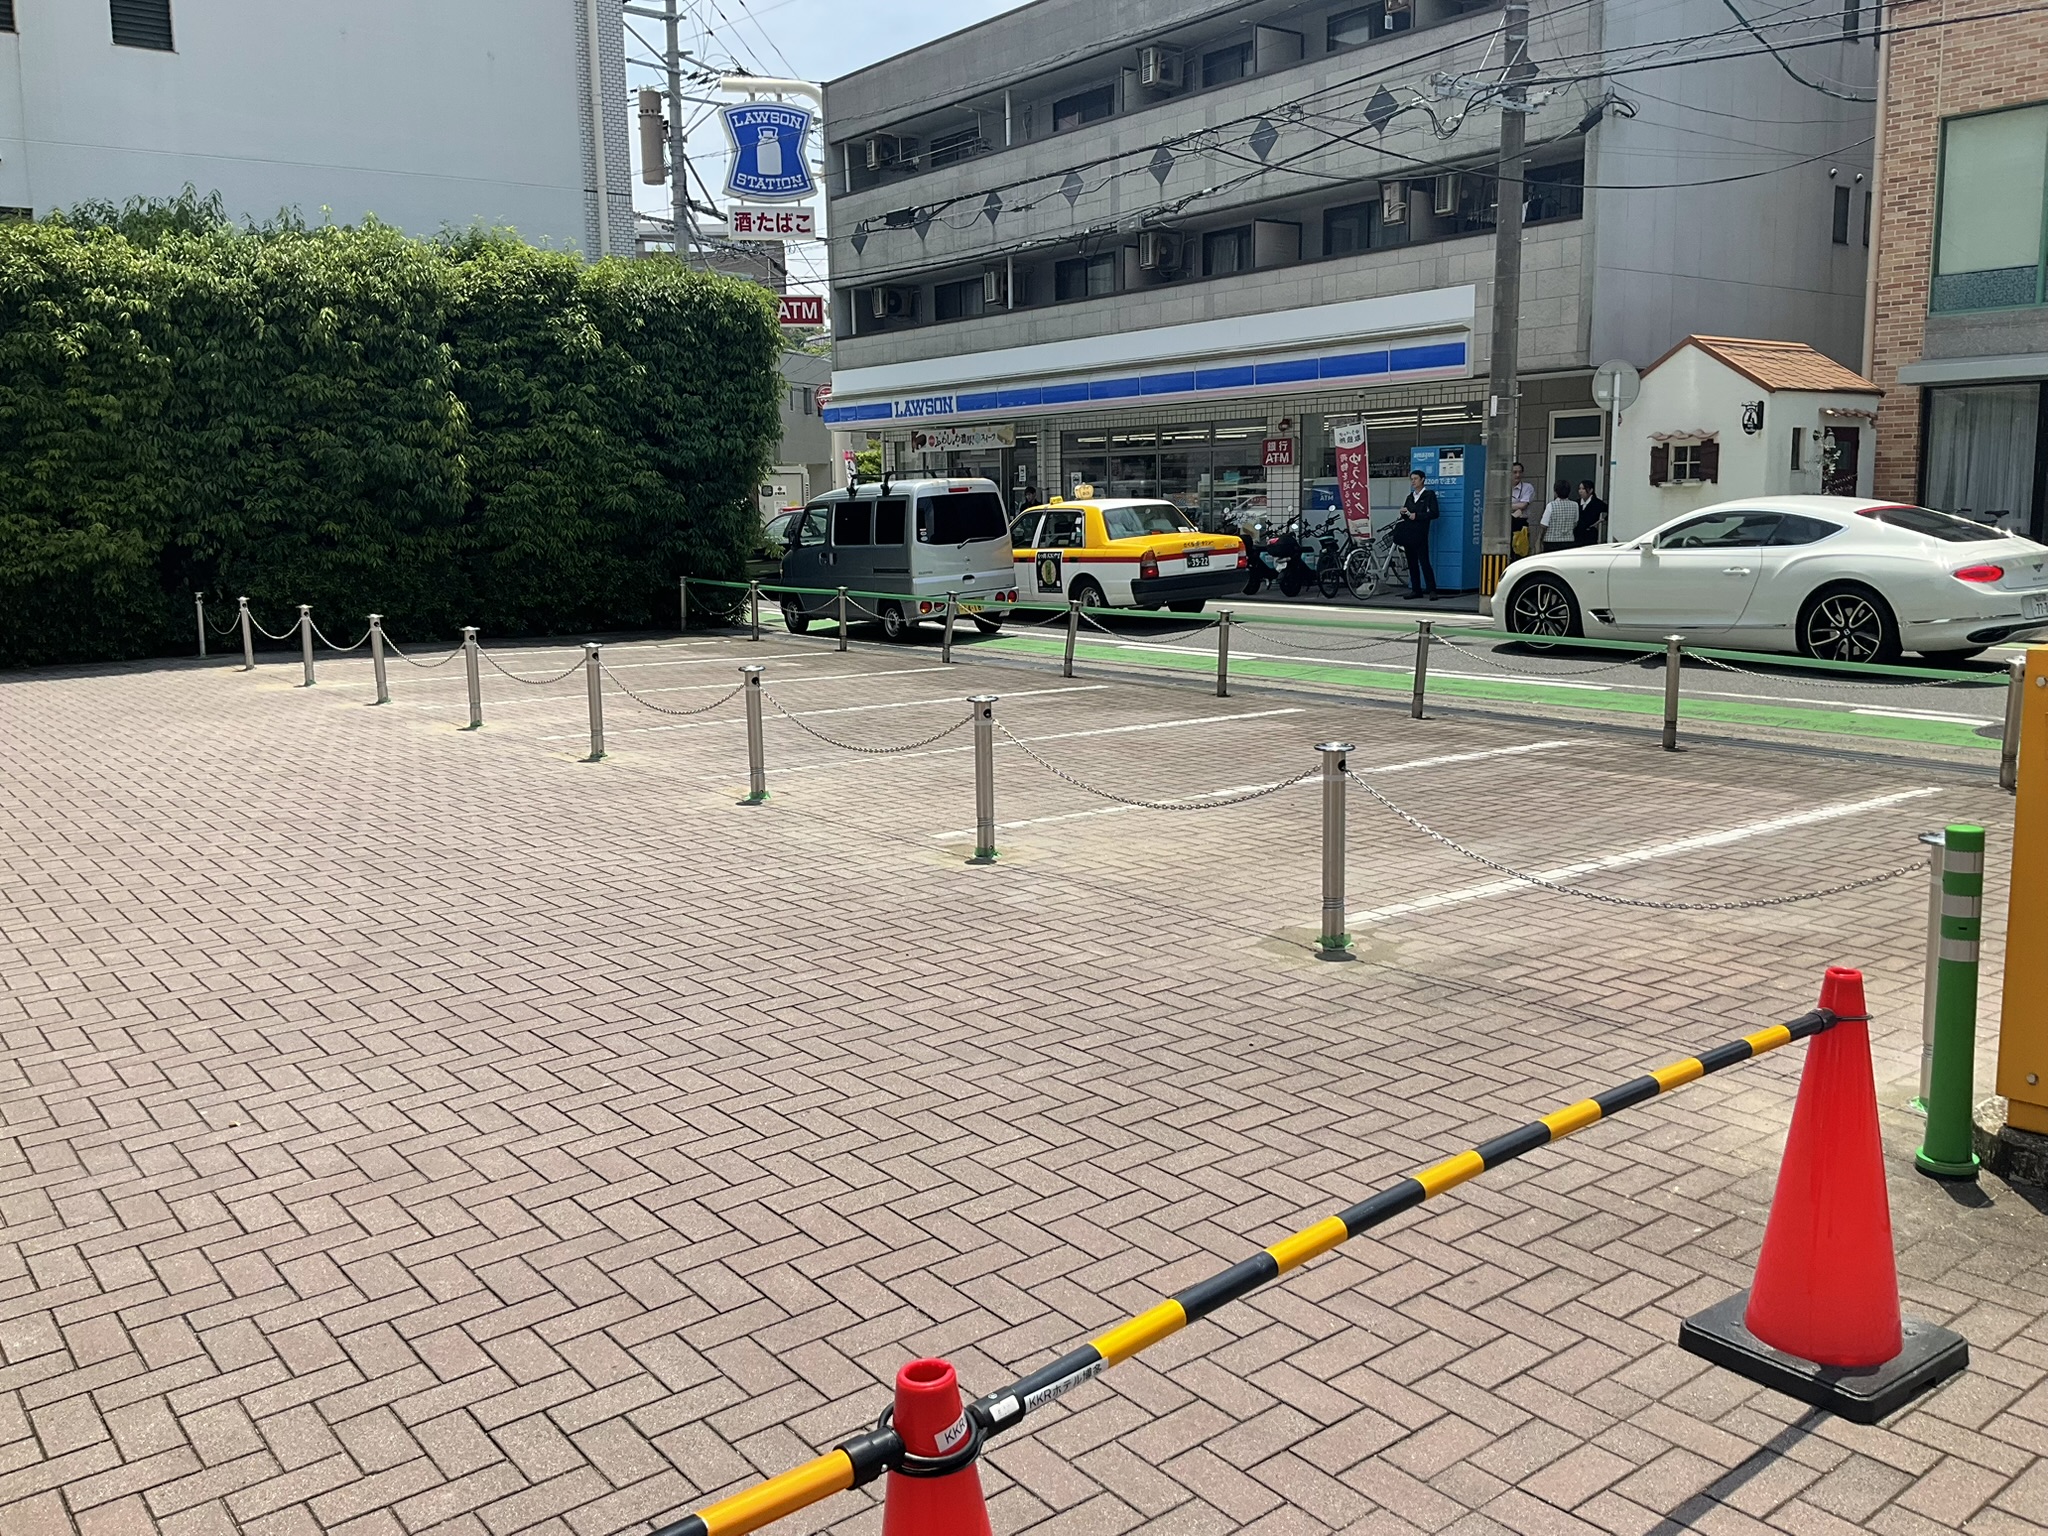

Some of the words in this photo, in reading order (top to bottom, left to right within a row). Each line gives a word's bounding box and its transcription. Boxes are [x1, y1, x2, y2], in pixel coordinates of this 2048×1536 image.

[732, 111, 803, 129] LAWSON
[736, 173, 803, 190] STATION
[778, 302, 817, 319] ATM
[894, 396, 954, 418] LAWSON
[1267, 441, 1288, 452] 銀行
[1265, 453, 1290, 464] ATM
[1472, 489, 1480, 545] amazon
[1028, 1363, 1102, 1409] KKRホテル博多
